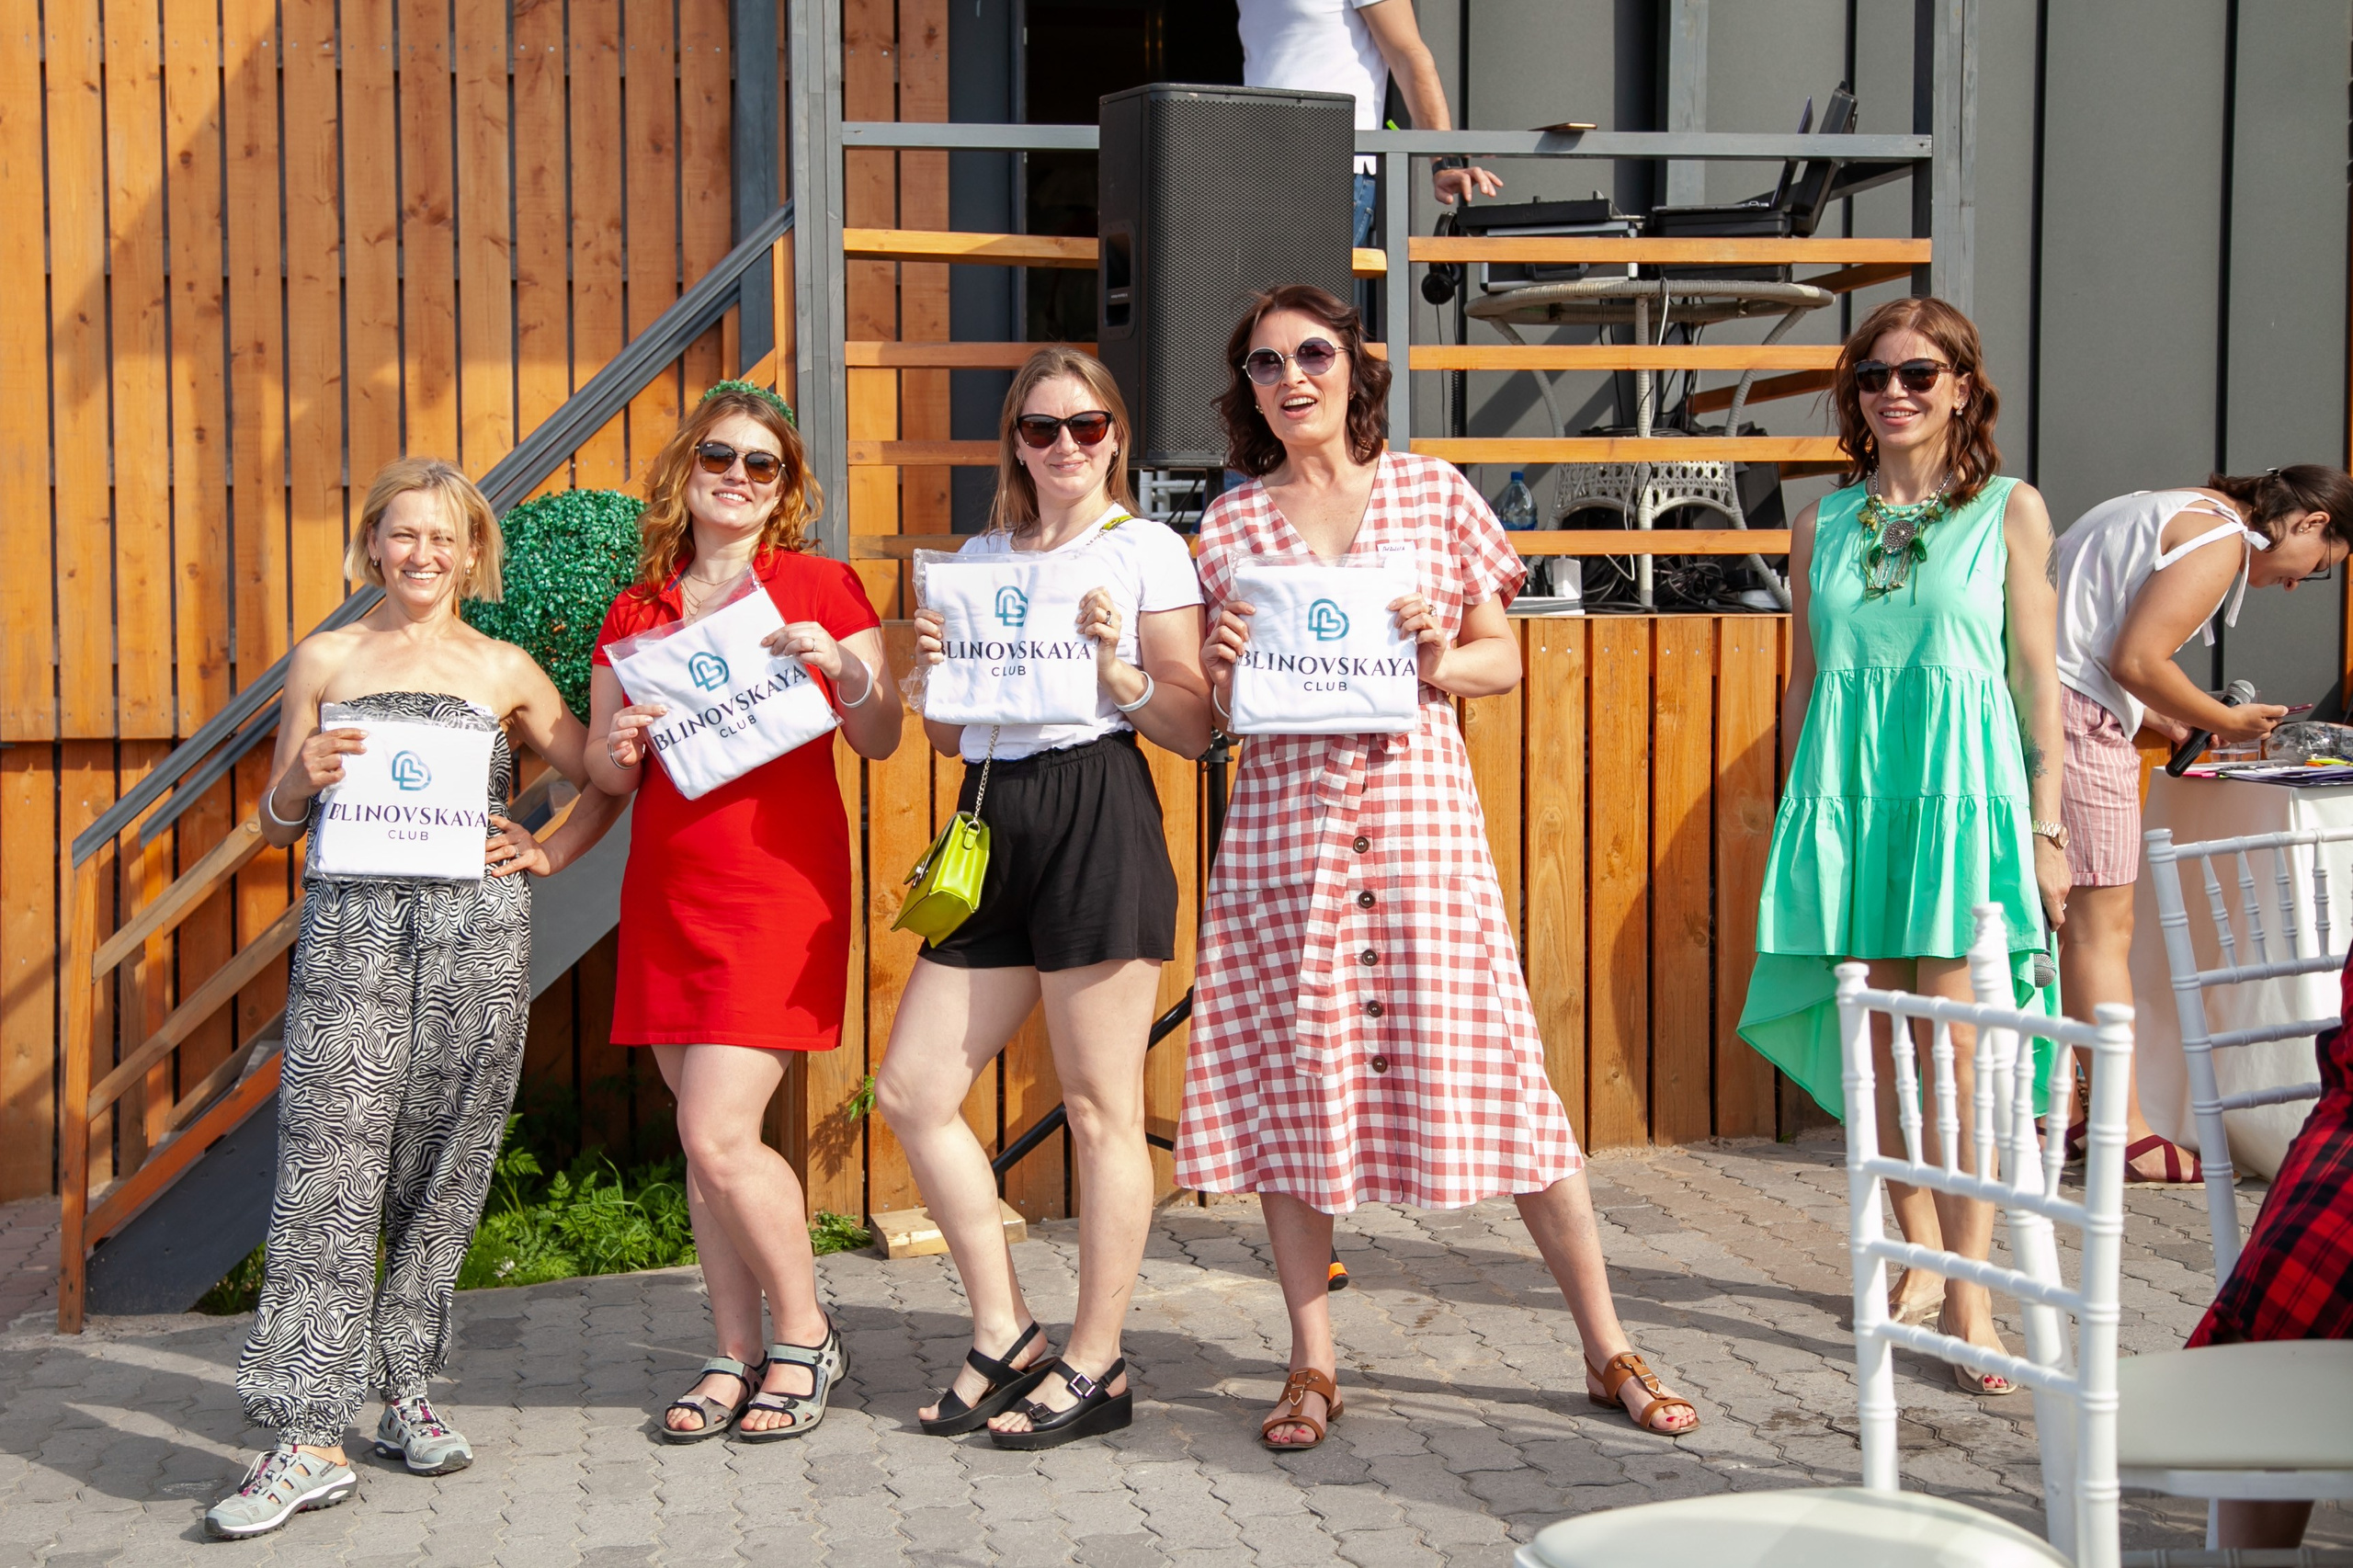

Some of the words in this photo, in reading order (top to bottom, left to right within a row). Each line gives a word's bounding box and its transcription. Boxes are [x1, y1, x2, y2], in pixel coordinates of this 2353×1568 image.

[992, 665, 1027, 676] CLUB
[1303, 680, 1347, 691] CLUB
[653, 665, 807, 751] BLINOVSKAYA
[720, 715, 757, 738] CLUB
[329, 802, 486, 827] BLINOVSKAYA
[388, 829, 428, 841] CLUB
